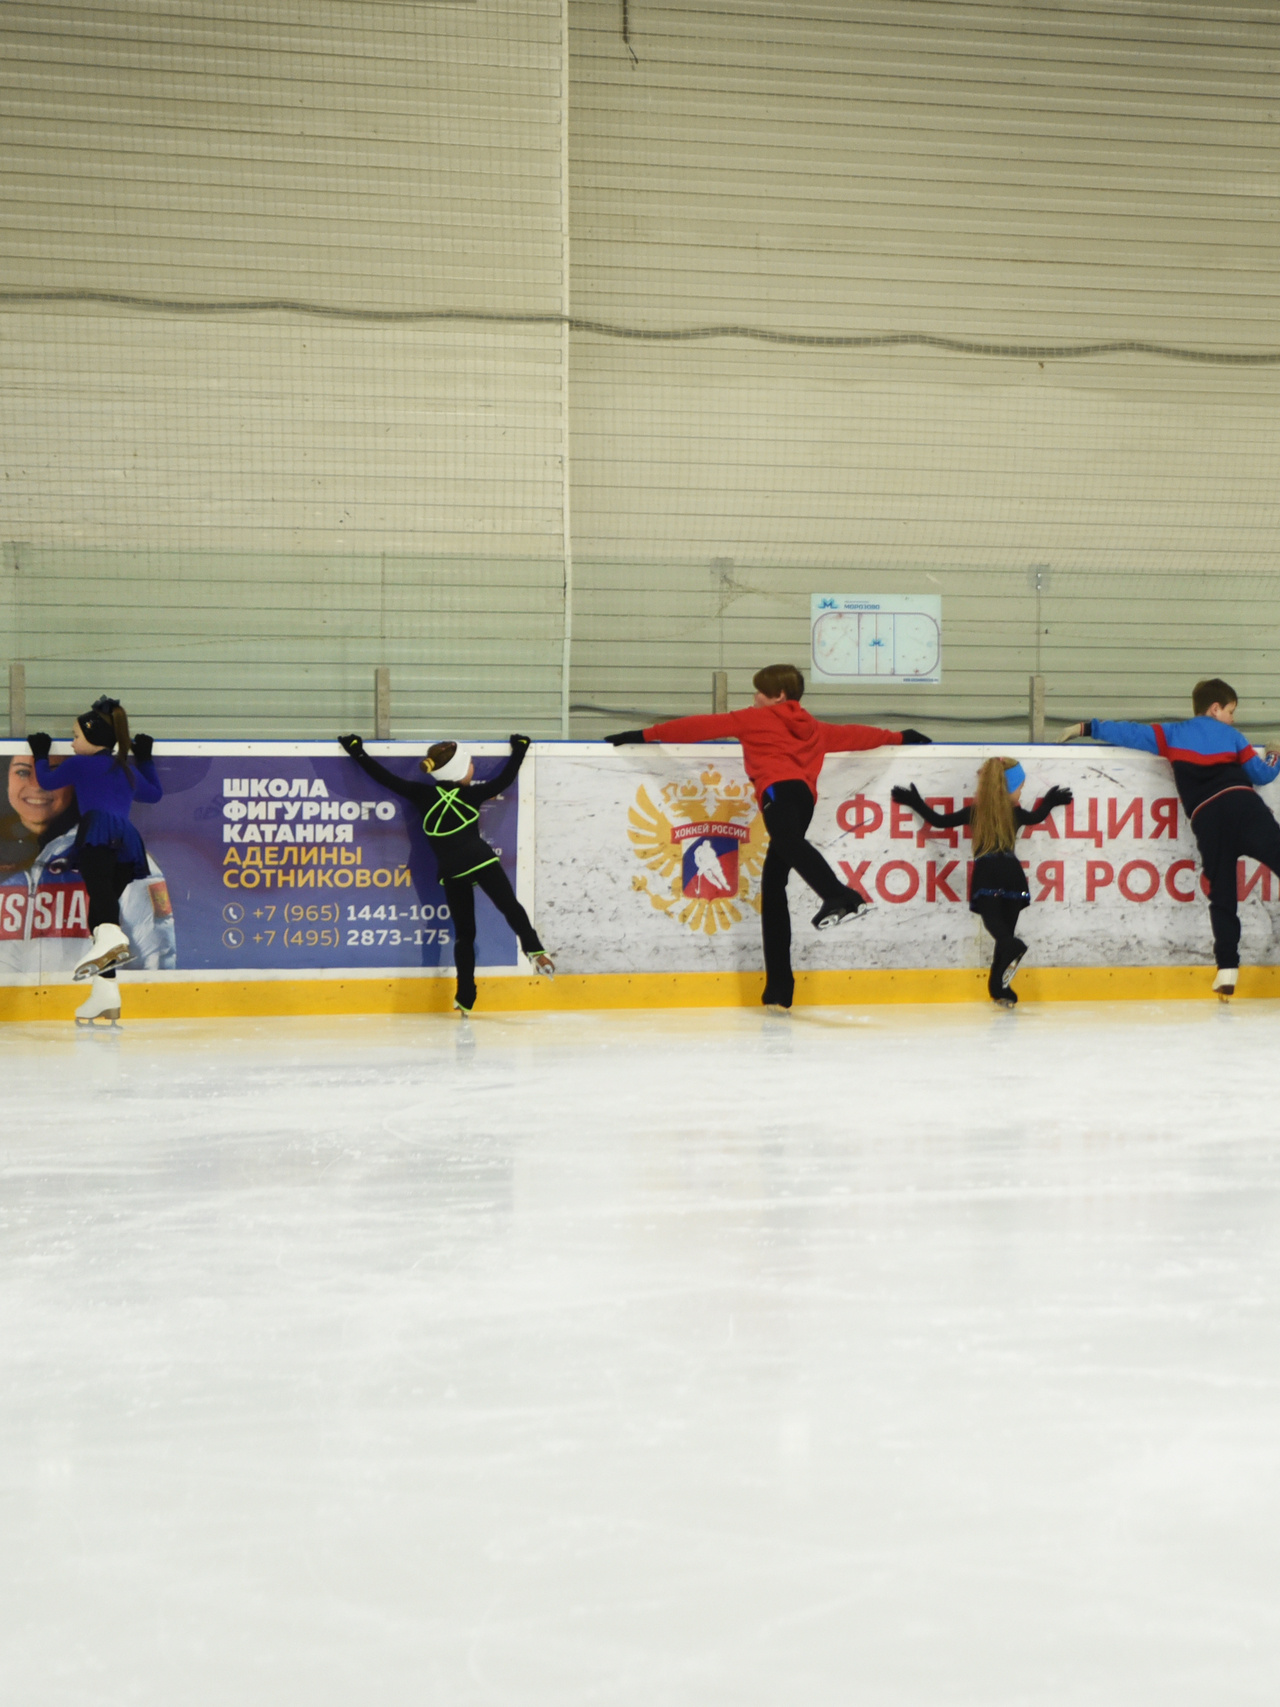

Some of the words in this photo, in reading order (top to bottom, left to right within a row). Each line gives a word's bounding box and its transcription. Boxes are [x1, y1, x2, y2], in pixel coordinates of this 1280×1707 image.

[223, 778, 329, 798] ШКОЛА
[223, 800, 396, 821] ФИГУРНОГО
[835, 793, 1179, 849] ФЕДАЦИЯ
[223, 823, 354, 843] КАТАНИЯ
[674, 823, 709, 839] ХОККЕЙ
[711, 824, 747, 839] РОССИИ
[223, 846, 362, 869] АДЕЛИНЫ
[223, 864, 411, 888] СОТНИКОВОЙ
[837, 859, 1065, 904] ХОКЯ
[0, 889, 88, 932] SSIA
[252, 905, 277, 921] +7
[283, 902, 340, 923] (965)
[346, 904, 451, 921] 1441-100
[252, 930, 277, 946] +7
[283, 927, 340, 948] (495)
[346, 929, 450, 946] 2873-175
